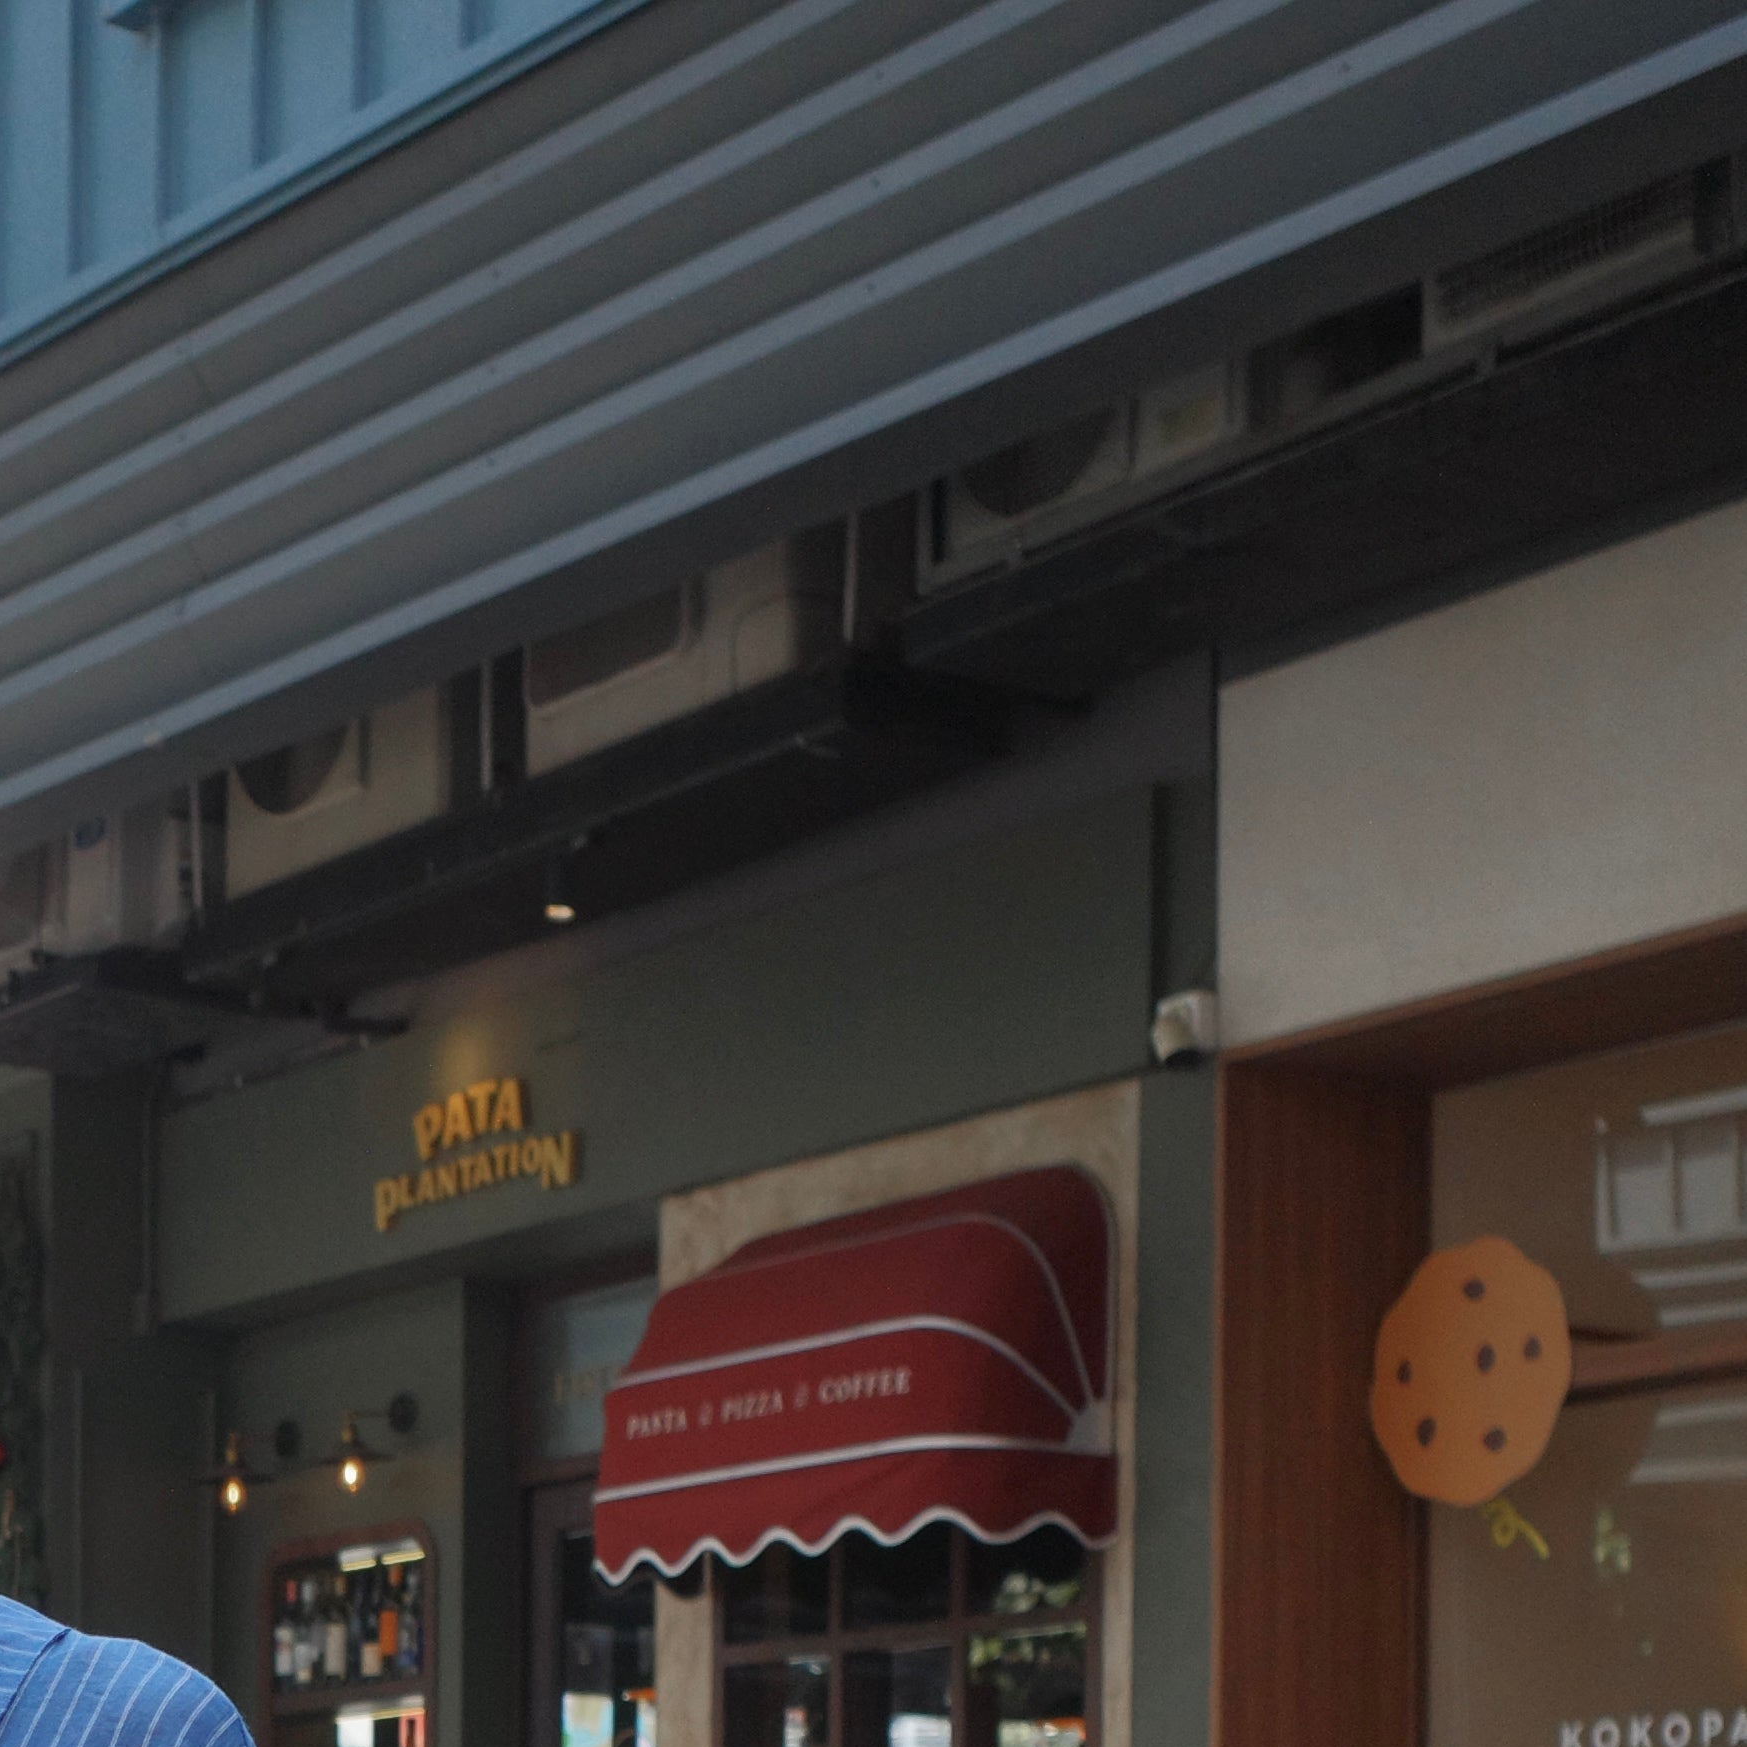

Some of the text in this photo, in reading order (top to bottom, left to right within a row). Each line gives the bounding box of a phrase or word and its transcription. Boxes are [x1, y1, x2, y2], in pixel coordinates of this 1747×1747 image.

[412, 1076, 524, 1162] PATA
[373, 1129, 574, 1232] PLANTATION
[625, 1366, 913, 1441] PASTA PIZZA COFFEE
